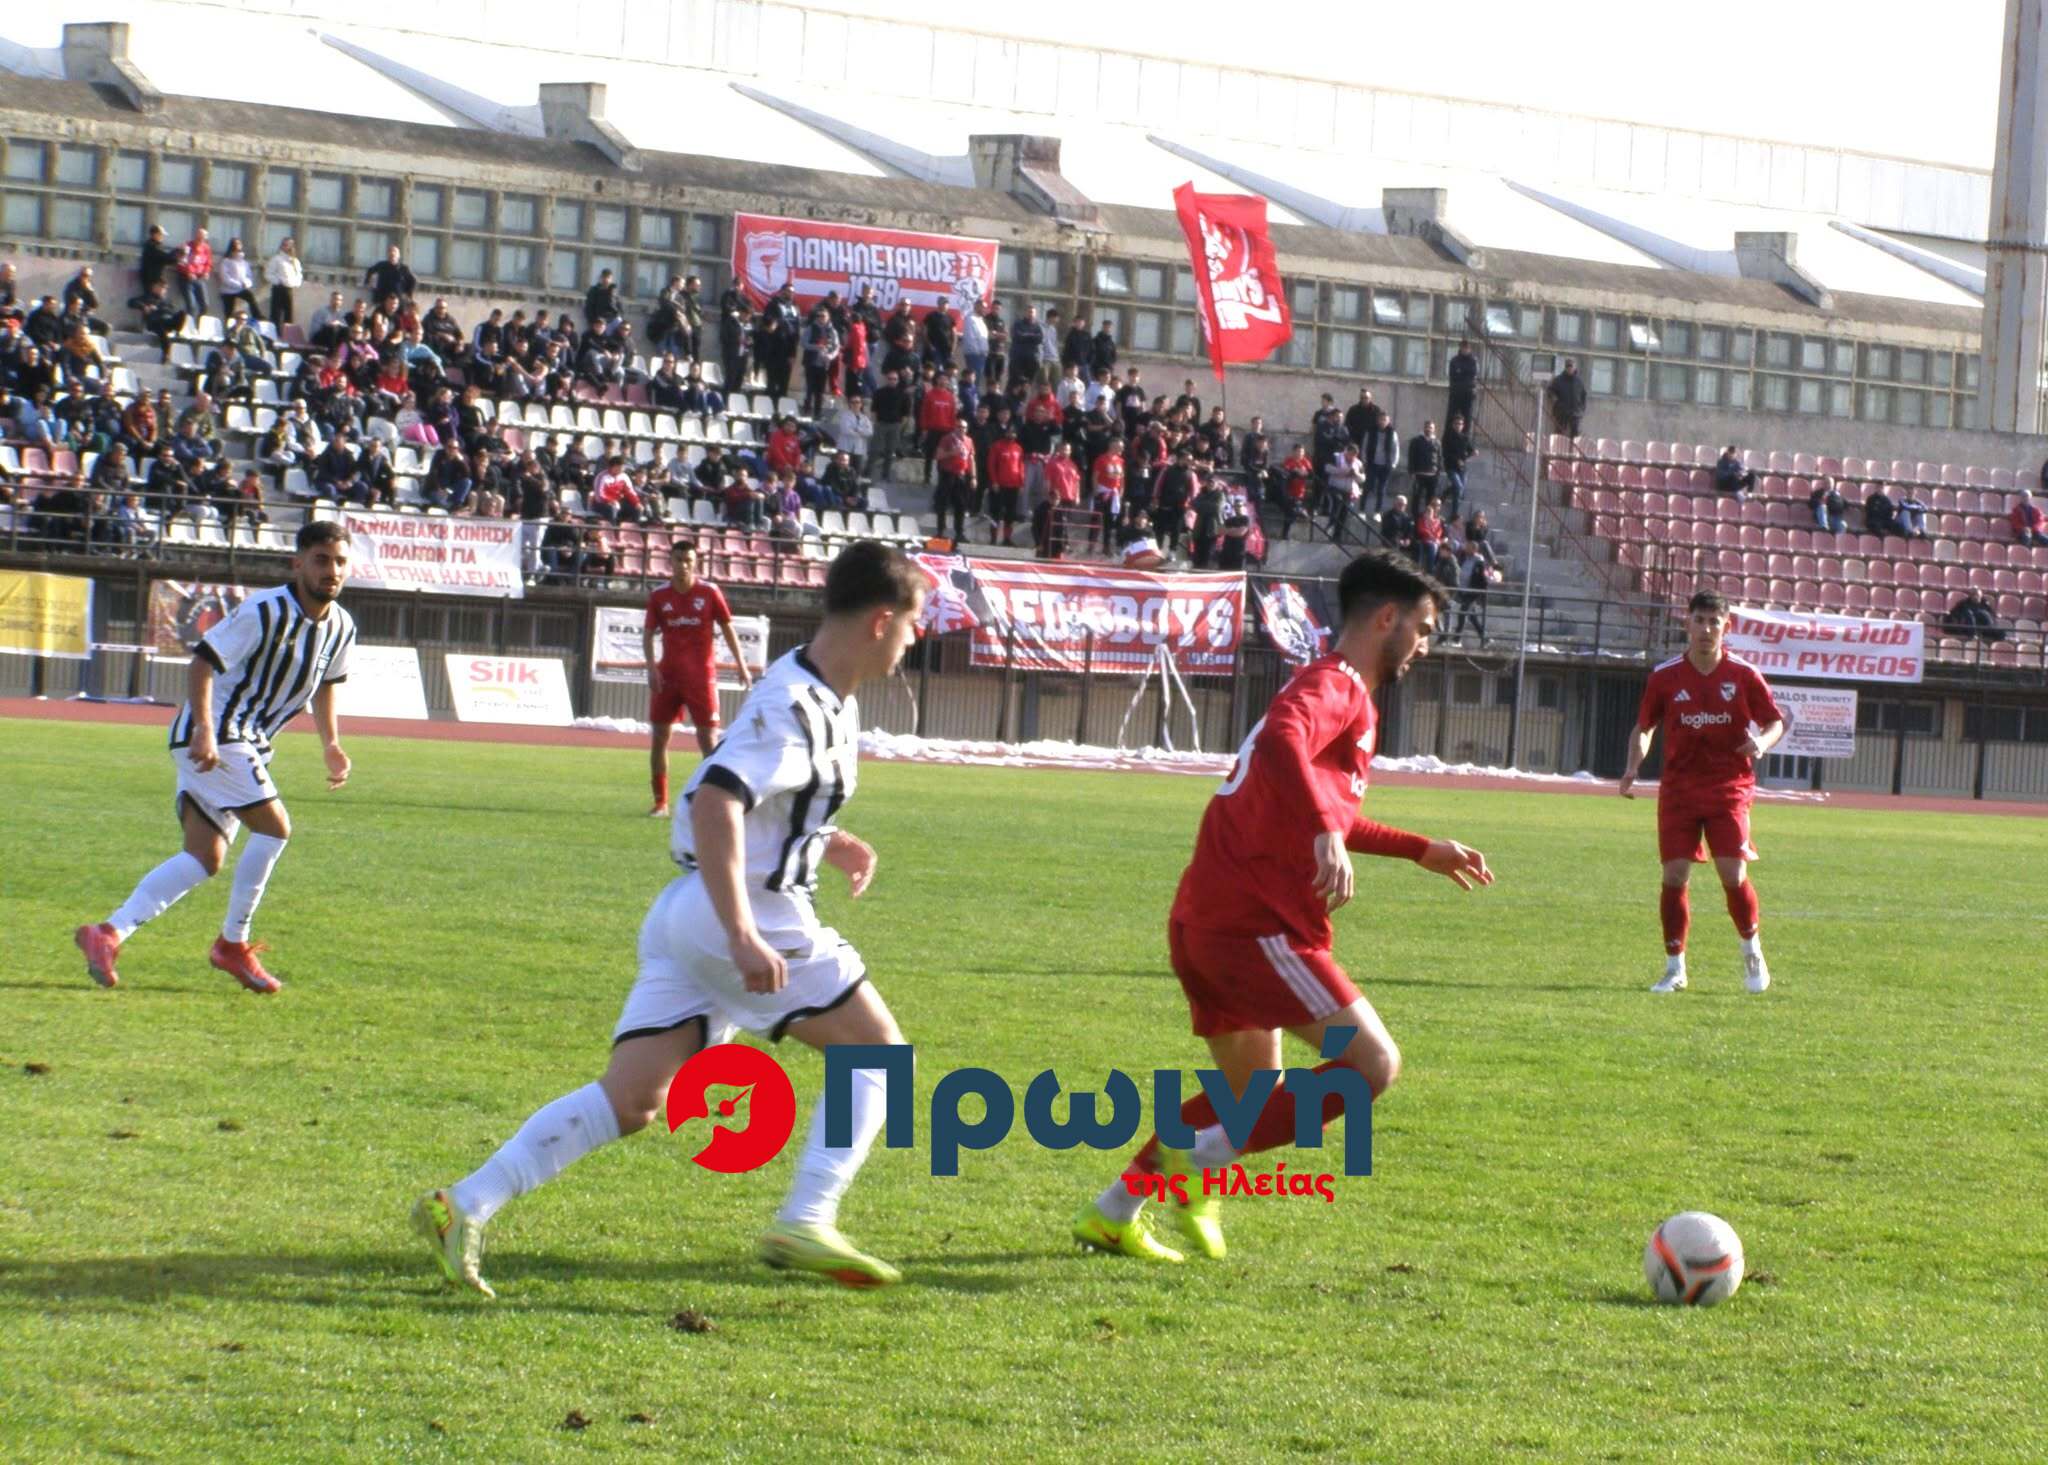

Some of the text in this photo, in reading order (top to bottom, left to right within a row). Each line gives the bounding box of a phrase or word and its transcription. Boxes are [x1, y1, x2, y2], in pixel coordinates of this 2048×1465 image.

[785, 235, 957, 283] ΠΑΝΗΛΕΙΑΚΟΣ
[453, 525, 513, 544] ΚΙΝΗΣΗ
[451, 547, 477, 564] ΓΙΑ
[384, 565, 436, 584] ΣΤΗΝ
[1109, 594, 1235, 648] BOYS
[1841, 621, 1912, 646] club
[1724, 642, 1919, 677] rom PYRGOS
[469, 660, 539, 684] Silk
[1680, 711, 1732, 729] logitech
